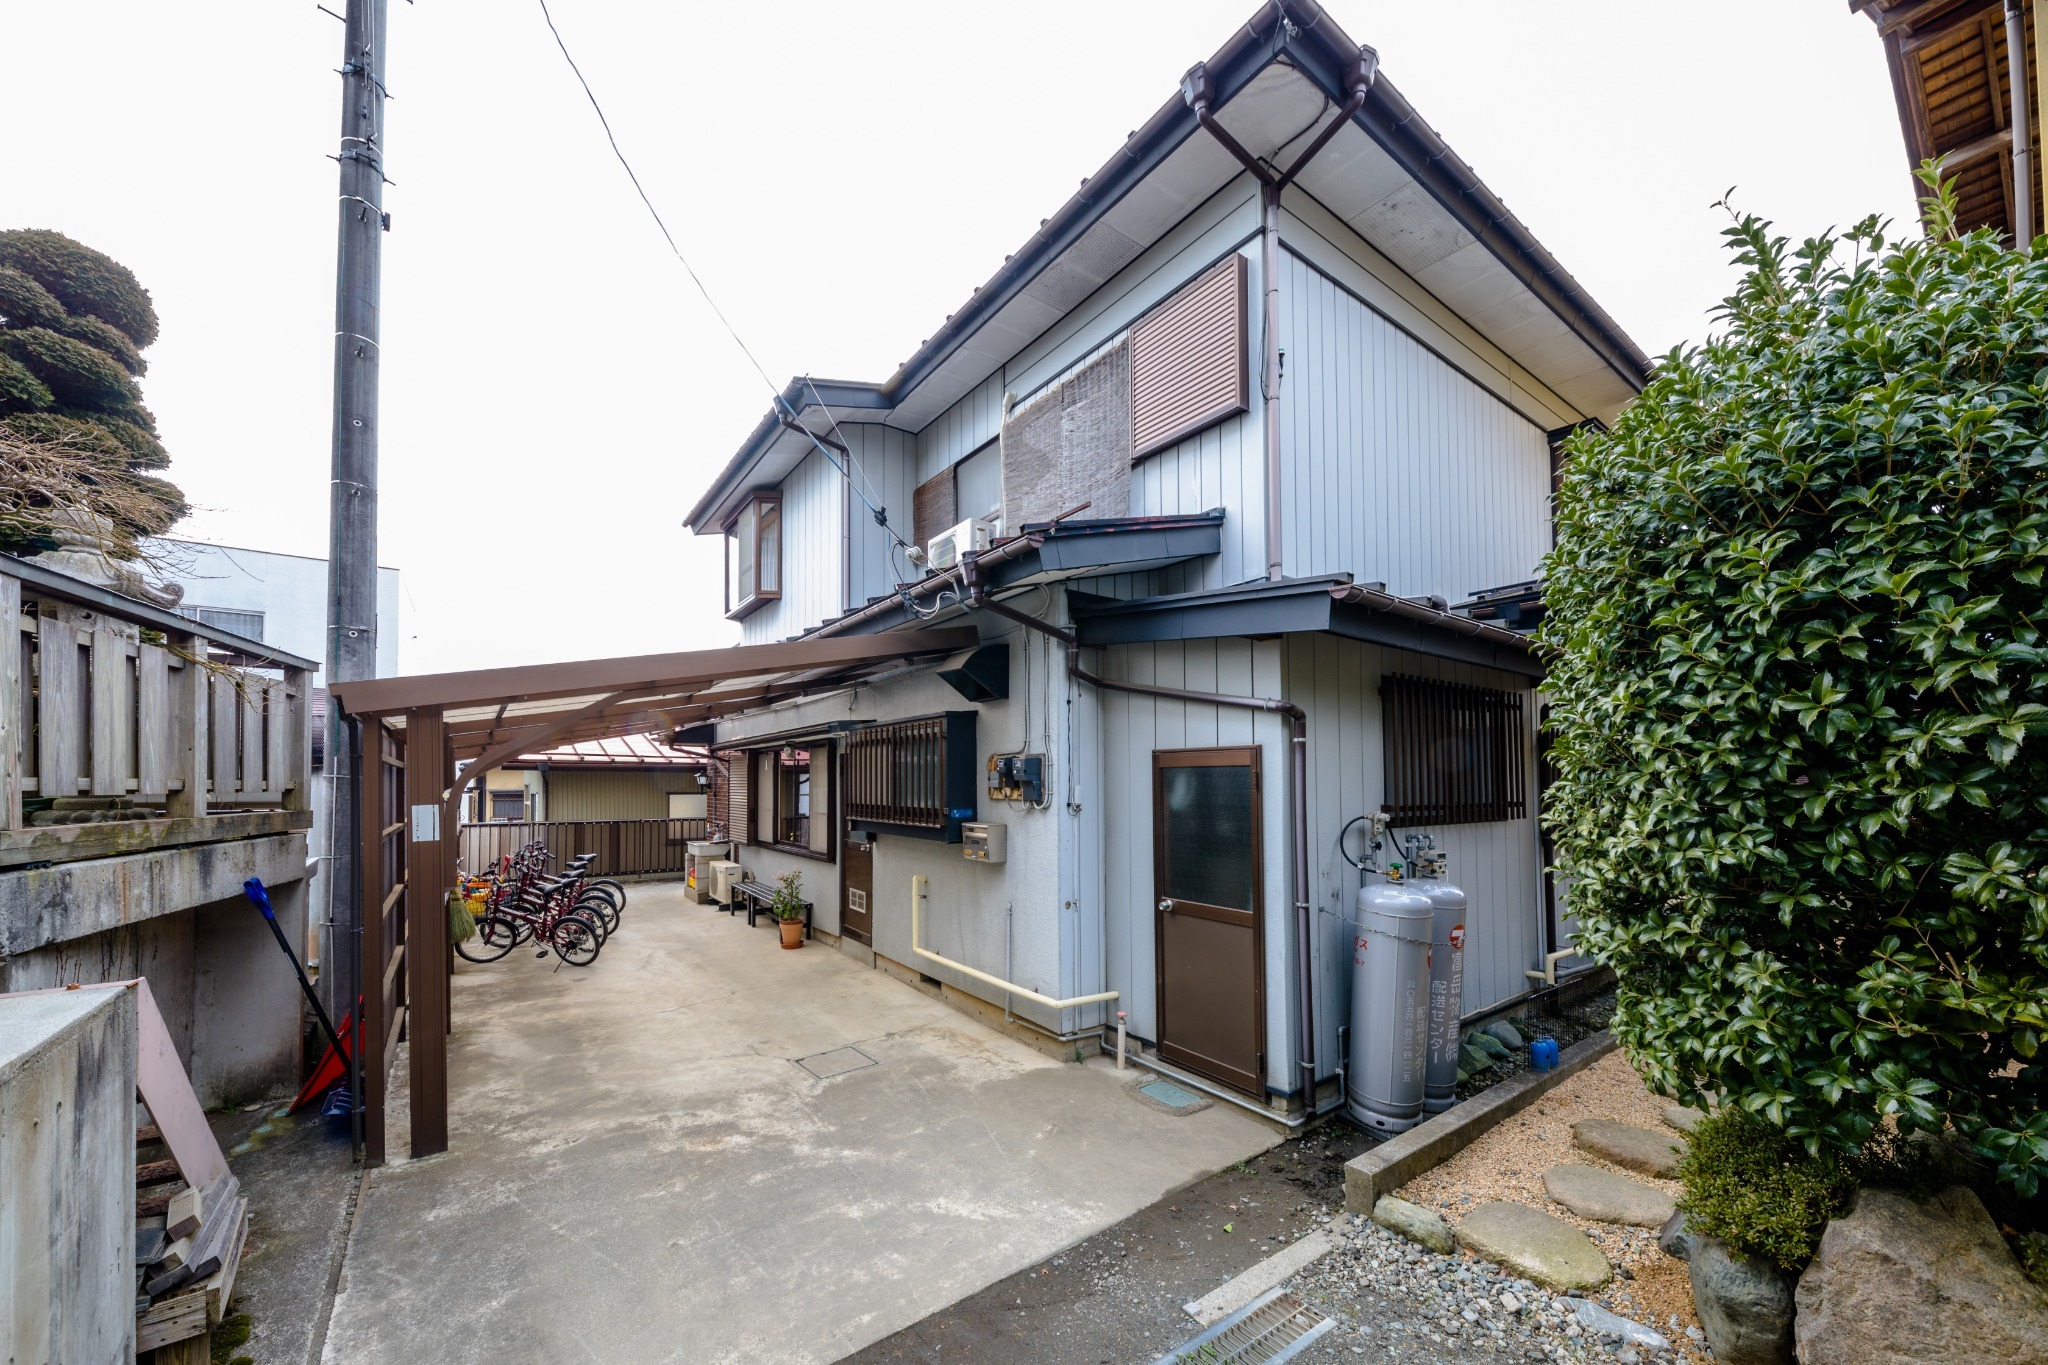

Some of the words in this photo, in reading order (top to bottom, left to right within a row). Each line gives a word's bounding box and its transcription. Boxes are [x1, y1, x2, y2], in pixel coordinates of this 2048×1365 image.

[1415, 1006, 1426, 1081] 配送センター
[1430, 980, 1447, 1064] 配送センター
